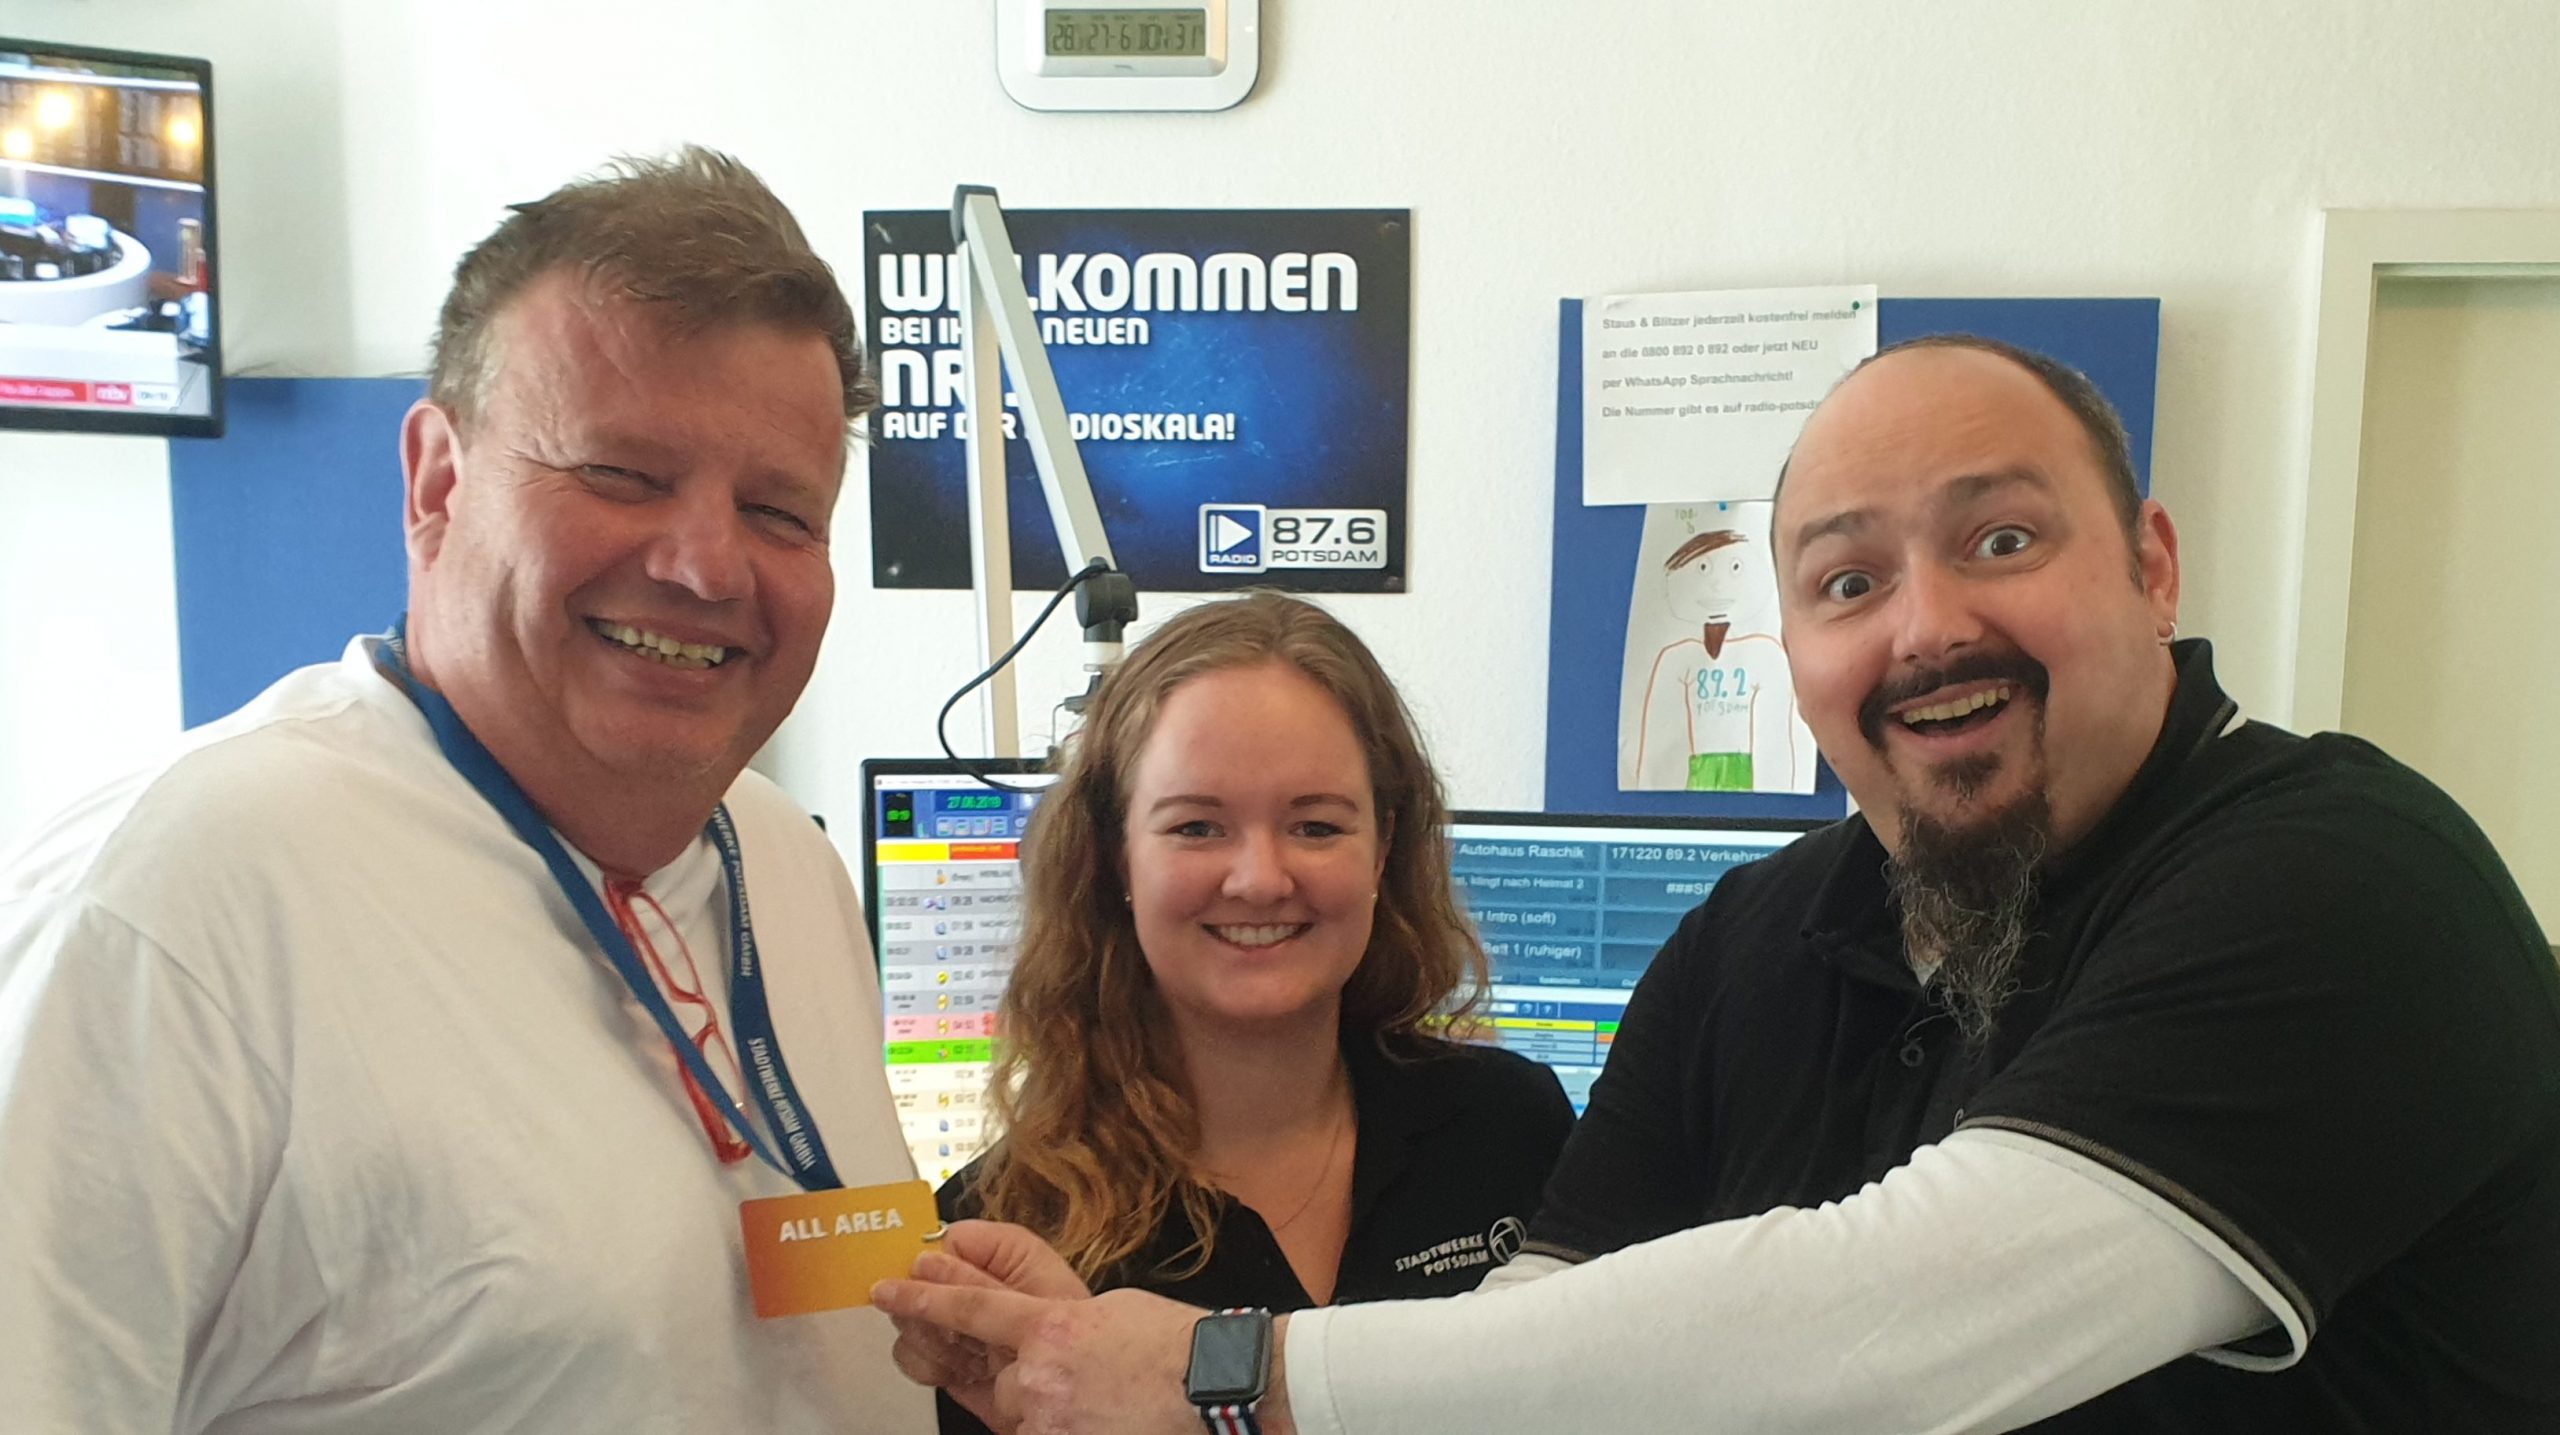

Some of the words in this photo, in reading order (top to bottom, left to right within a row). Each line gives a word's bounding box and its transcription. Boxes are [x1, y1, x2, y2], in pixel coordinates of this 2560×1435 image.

[879, 253, 1358, 312] WIKOMMEN
[1602, 319, 1636, 329] Staus
[1640, 317, 1648, 328] &
[1652, 316, 1690, 327] Blitzer
[1693, 313, 1745, 328] jederzeit
[1748, 311, 1809, 323] kostenfrei
[1812, 309, 1857, 321] melden
[880, 317, 931, 344] BEI
[1043, 318, 1149, 345] NEUEN
[1602, 350, 1617, 359] an
[1620, 347, 1638, 359] die
[1732, 342, 1760, 354] oder
[1763, 341, 1789, 355] jetzt
[1792, 340, 1818, 351] NEU
[1602, 378, 1622, 390] per
[1625, 375, 1687, 388] WhatsApp
[1691, 371, 1793, 386] Sprachnachricht!
[1602, 407, 1621, 417] Die
[1625, 405, 1674, 416] Nummer
[1678, 403, 1702, 417] gibt
[1705, 404, 1719, 414] es
[1722, 402, 1742, 413] auf
[883, 412, 947, 439] AUF
[954, 412, 1017, 440] DR
[1273, 517, 1375, 544] 87.6
[1210, 554, 1256, 564] RADIO
[1272, 550, 1378, 563] POTSDAM
[1697, 668, 1746, 699] 89.2
[1459, 843, 1525, 857] Autohaus
[1529, 845, 1585, 858] Raschik
[1612, 848, 1662, 860] 171220
[779, 1217, 828, 1242] ALL
[835, 1208, 903, 1236] AREA
[1395, 1233, 1485, 1272] STADTWERKE
[1423, 1250, 1490, 1277] POTSDAM
